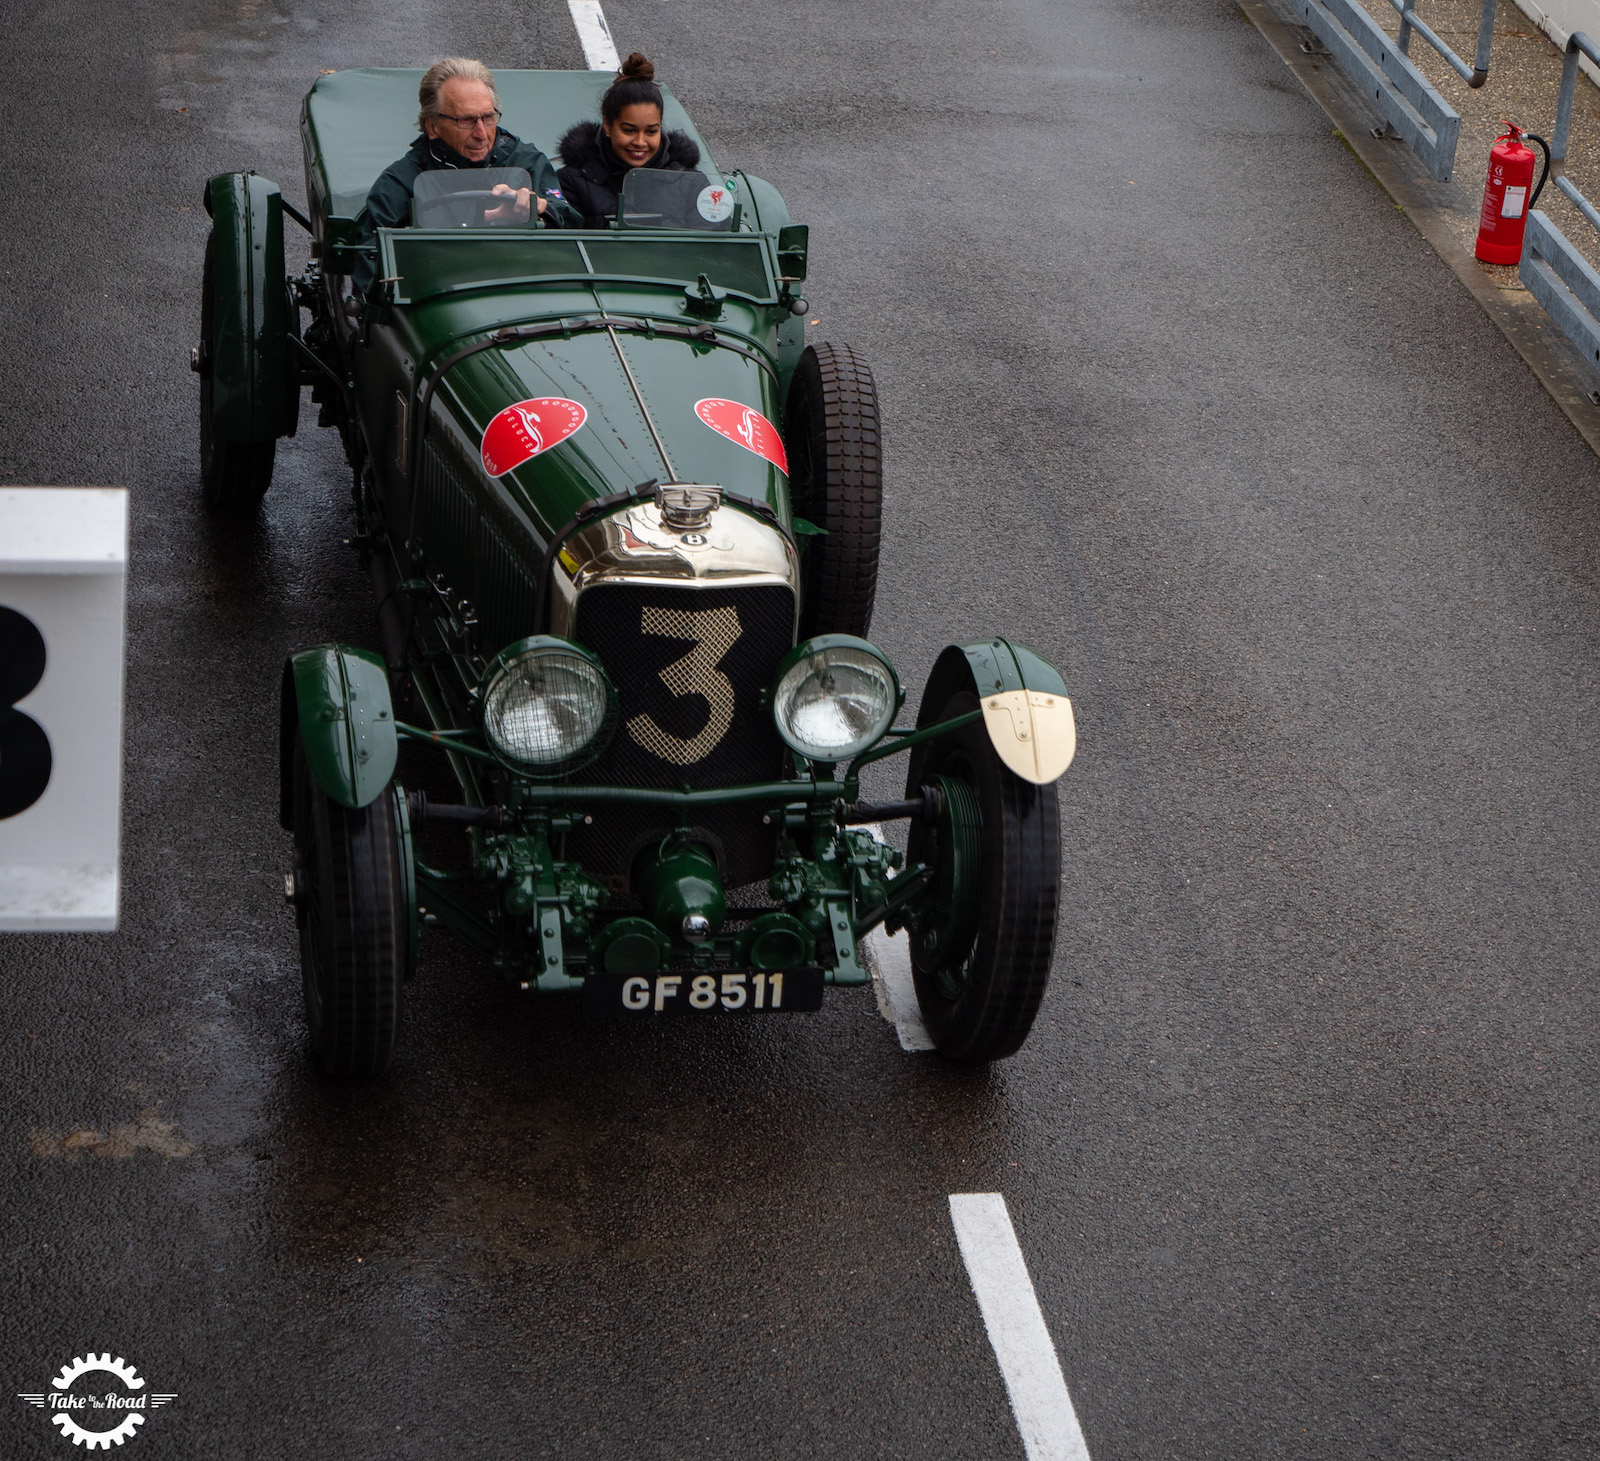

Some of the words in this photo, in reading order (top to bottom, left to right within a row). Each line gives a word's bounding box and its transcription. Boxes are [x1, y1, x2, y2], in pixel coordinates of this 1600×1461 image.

[502, 410, 534, 449] VELOCE
[541, 400, 580, 434] GOODWOOD
[686, 533, 704, 545] B
[626, 605, 744, 766] 3
[621, 975, 682, 1011] GF
[688, 972, 784, 1010] 8511
